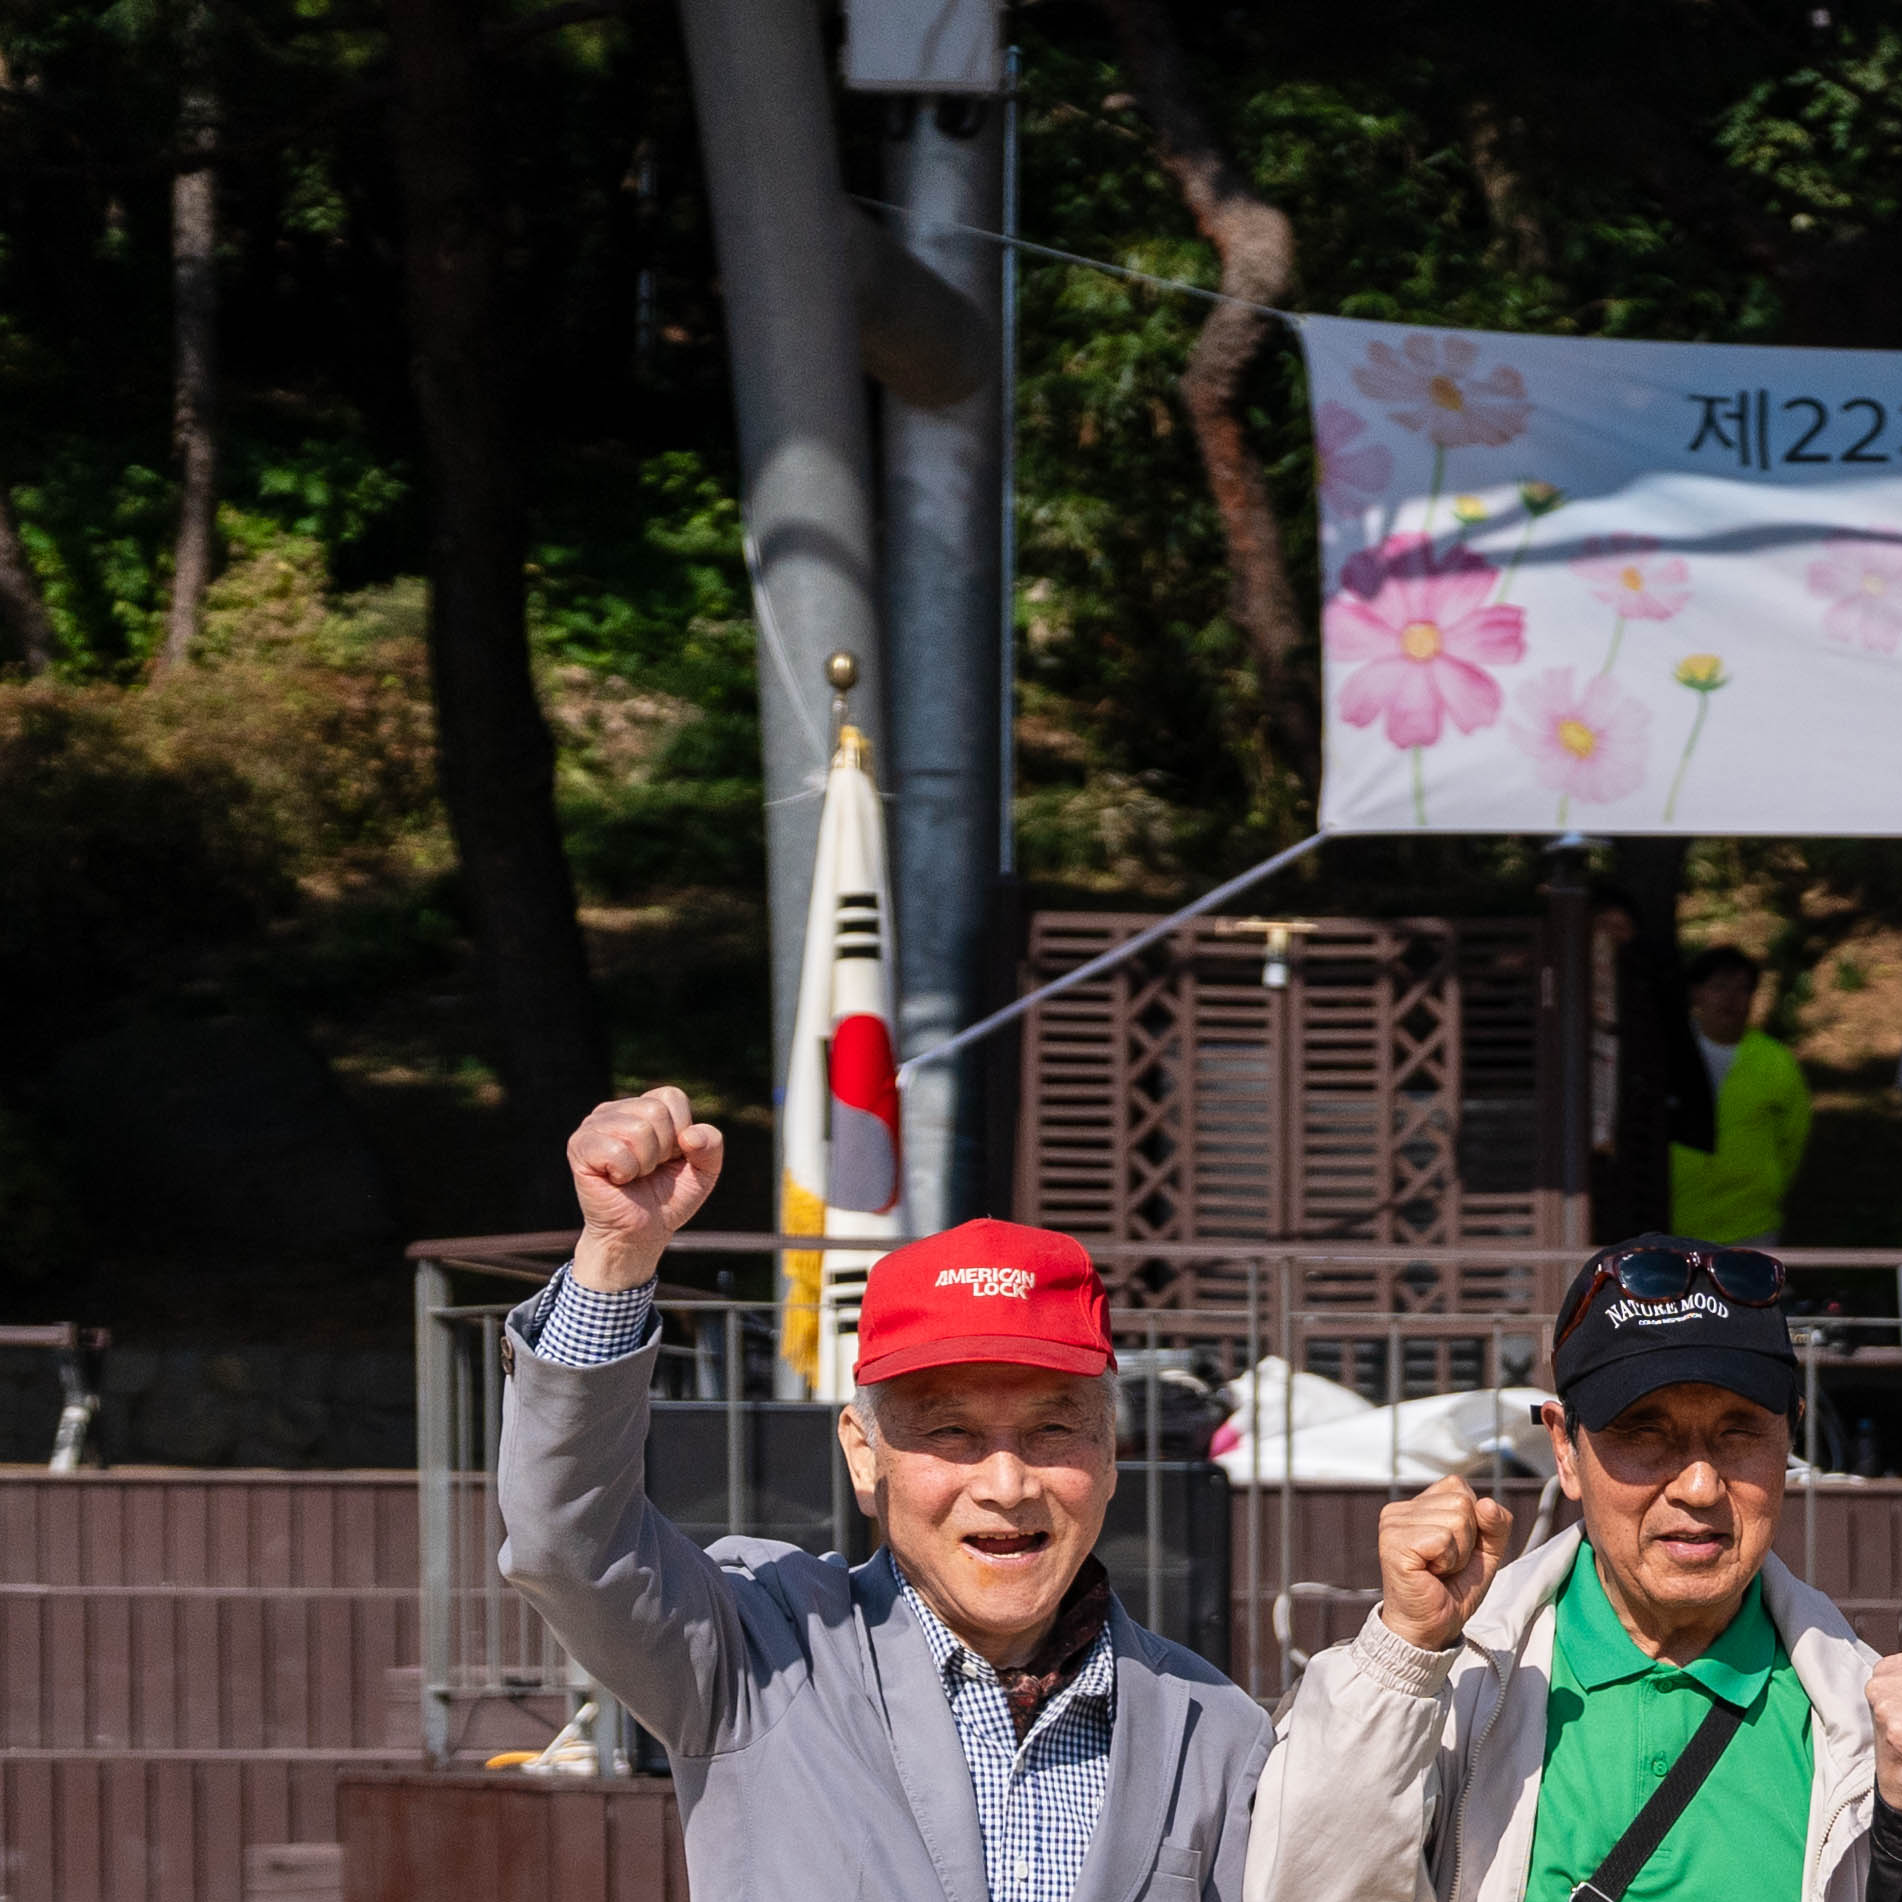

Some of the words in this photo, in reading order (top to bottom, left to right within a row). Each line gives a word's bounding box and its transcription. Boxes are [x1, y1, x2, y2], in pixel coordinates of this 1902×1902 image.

[935, 1267, 1035, 1288] AMERICAN
[973, 1282, 1028, 1300] LOCK
[1605, 1299, 1679, 1329] NATURE
[1680, 1292, 1729, 1319] MOOD
